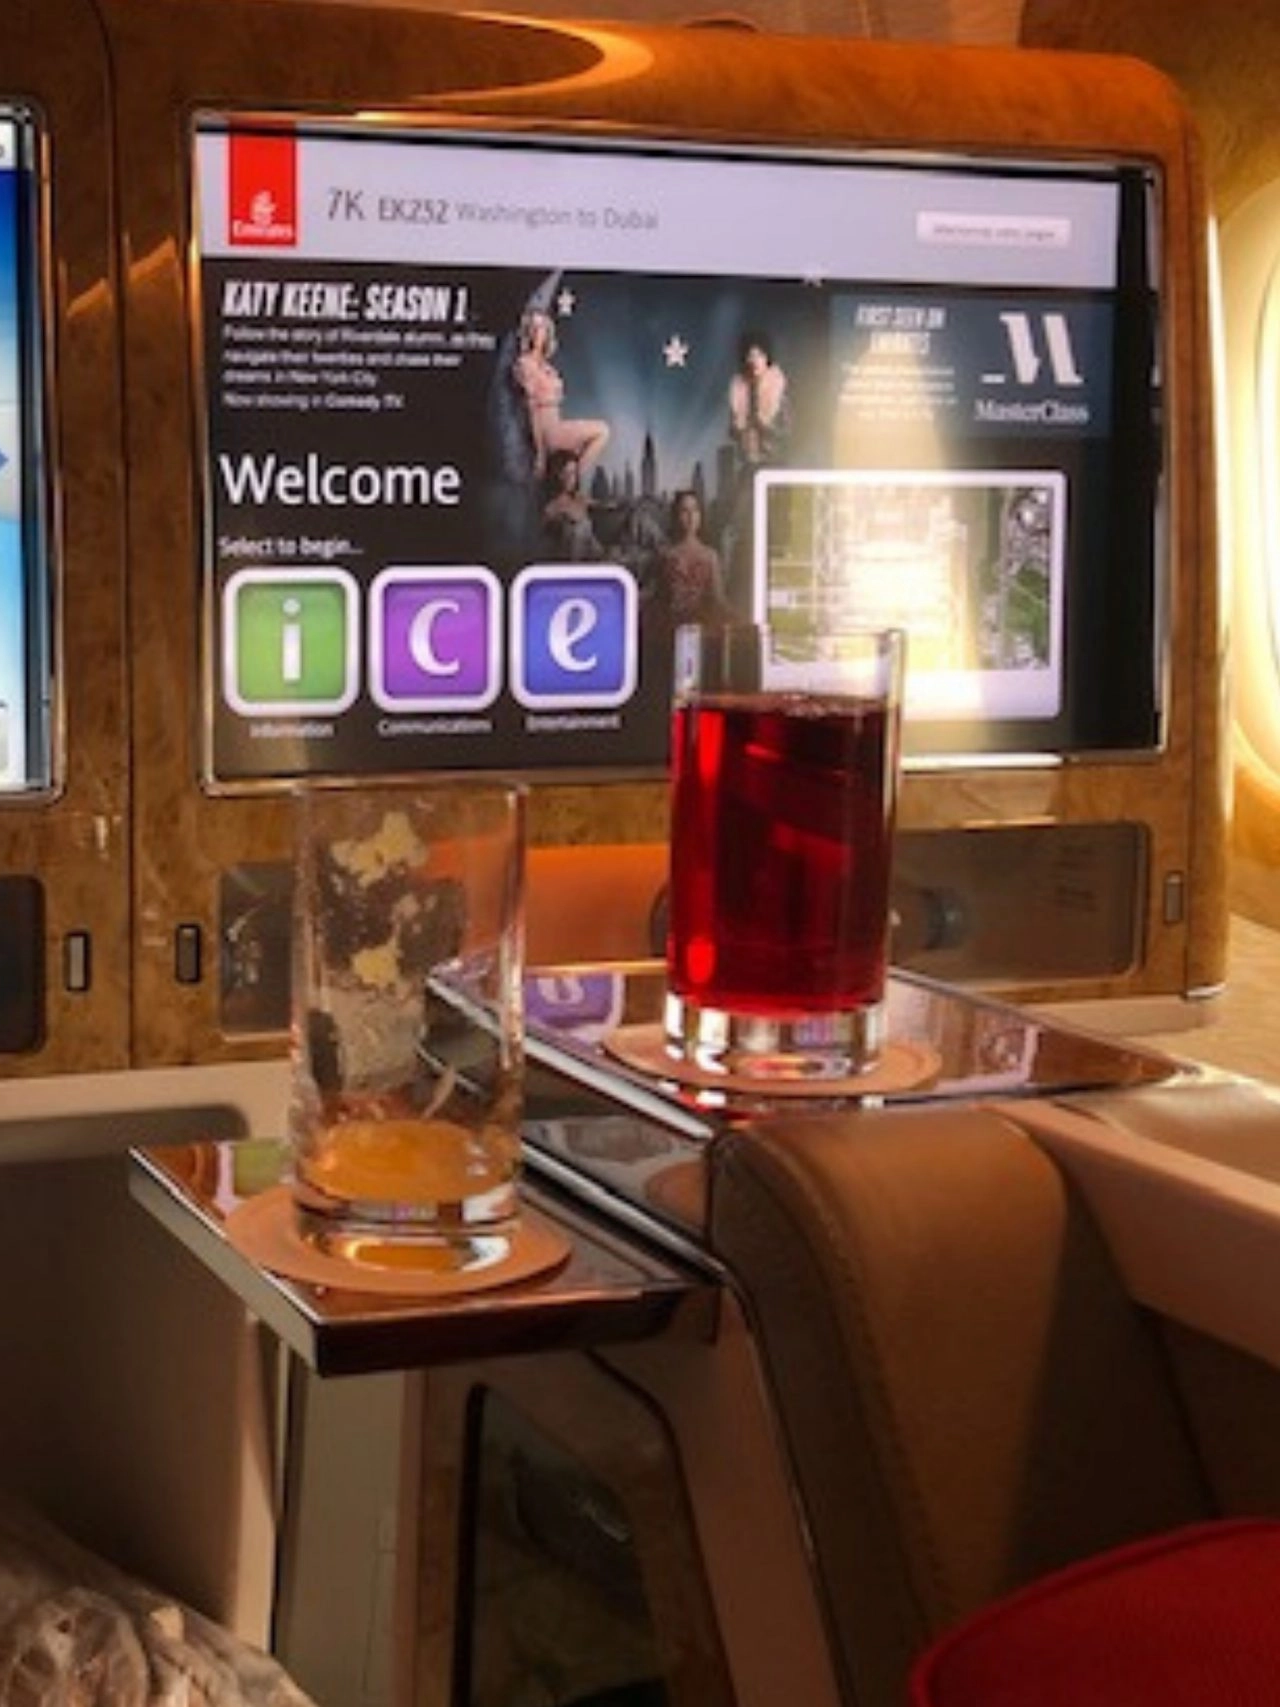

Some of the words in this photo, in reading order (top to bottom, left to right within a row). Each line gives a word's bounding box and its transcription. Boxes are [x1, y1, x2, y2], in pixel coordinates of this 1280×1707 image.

[326, 188, 368, 221] 7K
[456, 202, 571, 230] Washington
[577, 206, 597, 228] to
[602, 206, 659, 230] Dubai
[223, 281, 280, 318] KATY
[282, 282, 360, 319] KEENE:
[364, 284, 452, 322] SEASON
[219, 454, 462, 504] Welcome
[219, 536, 274, 558] Select
[277, 539, 297, 557] to
[282, 596, 303, 682] i
